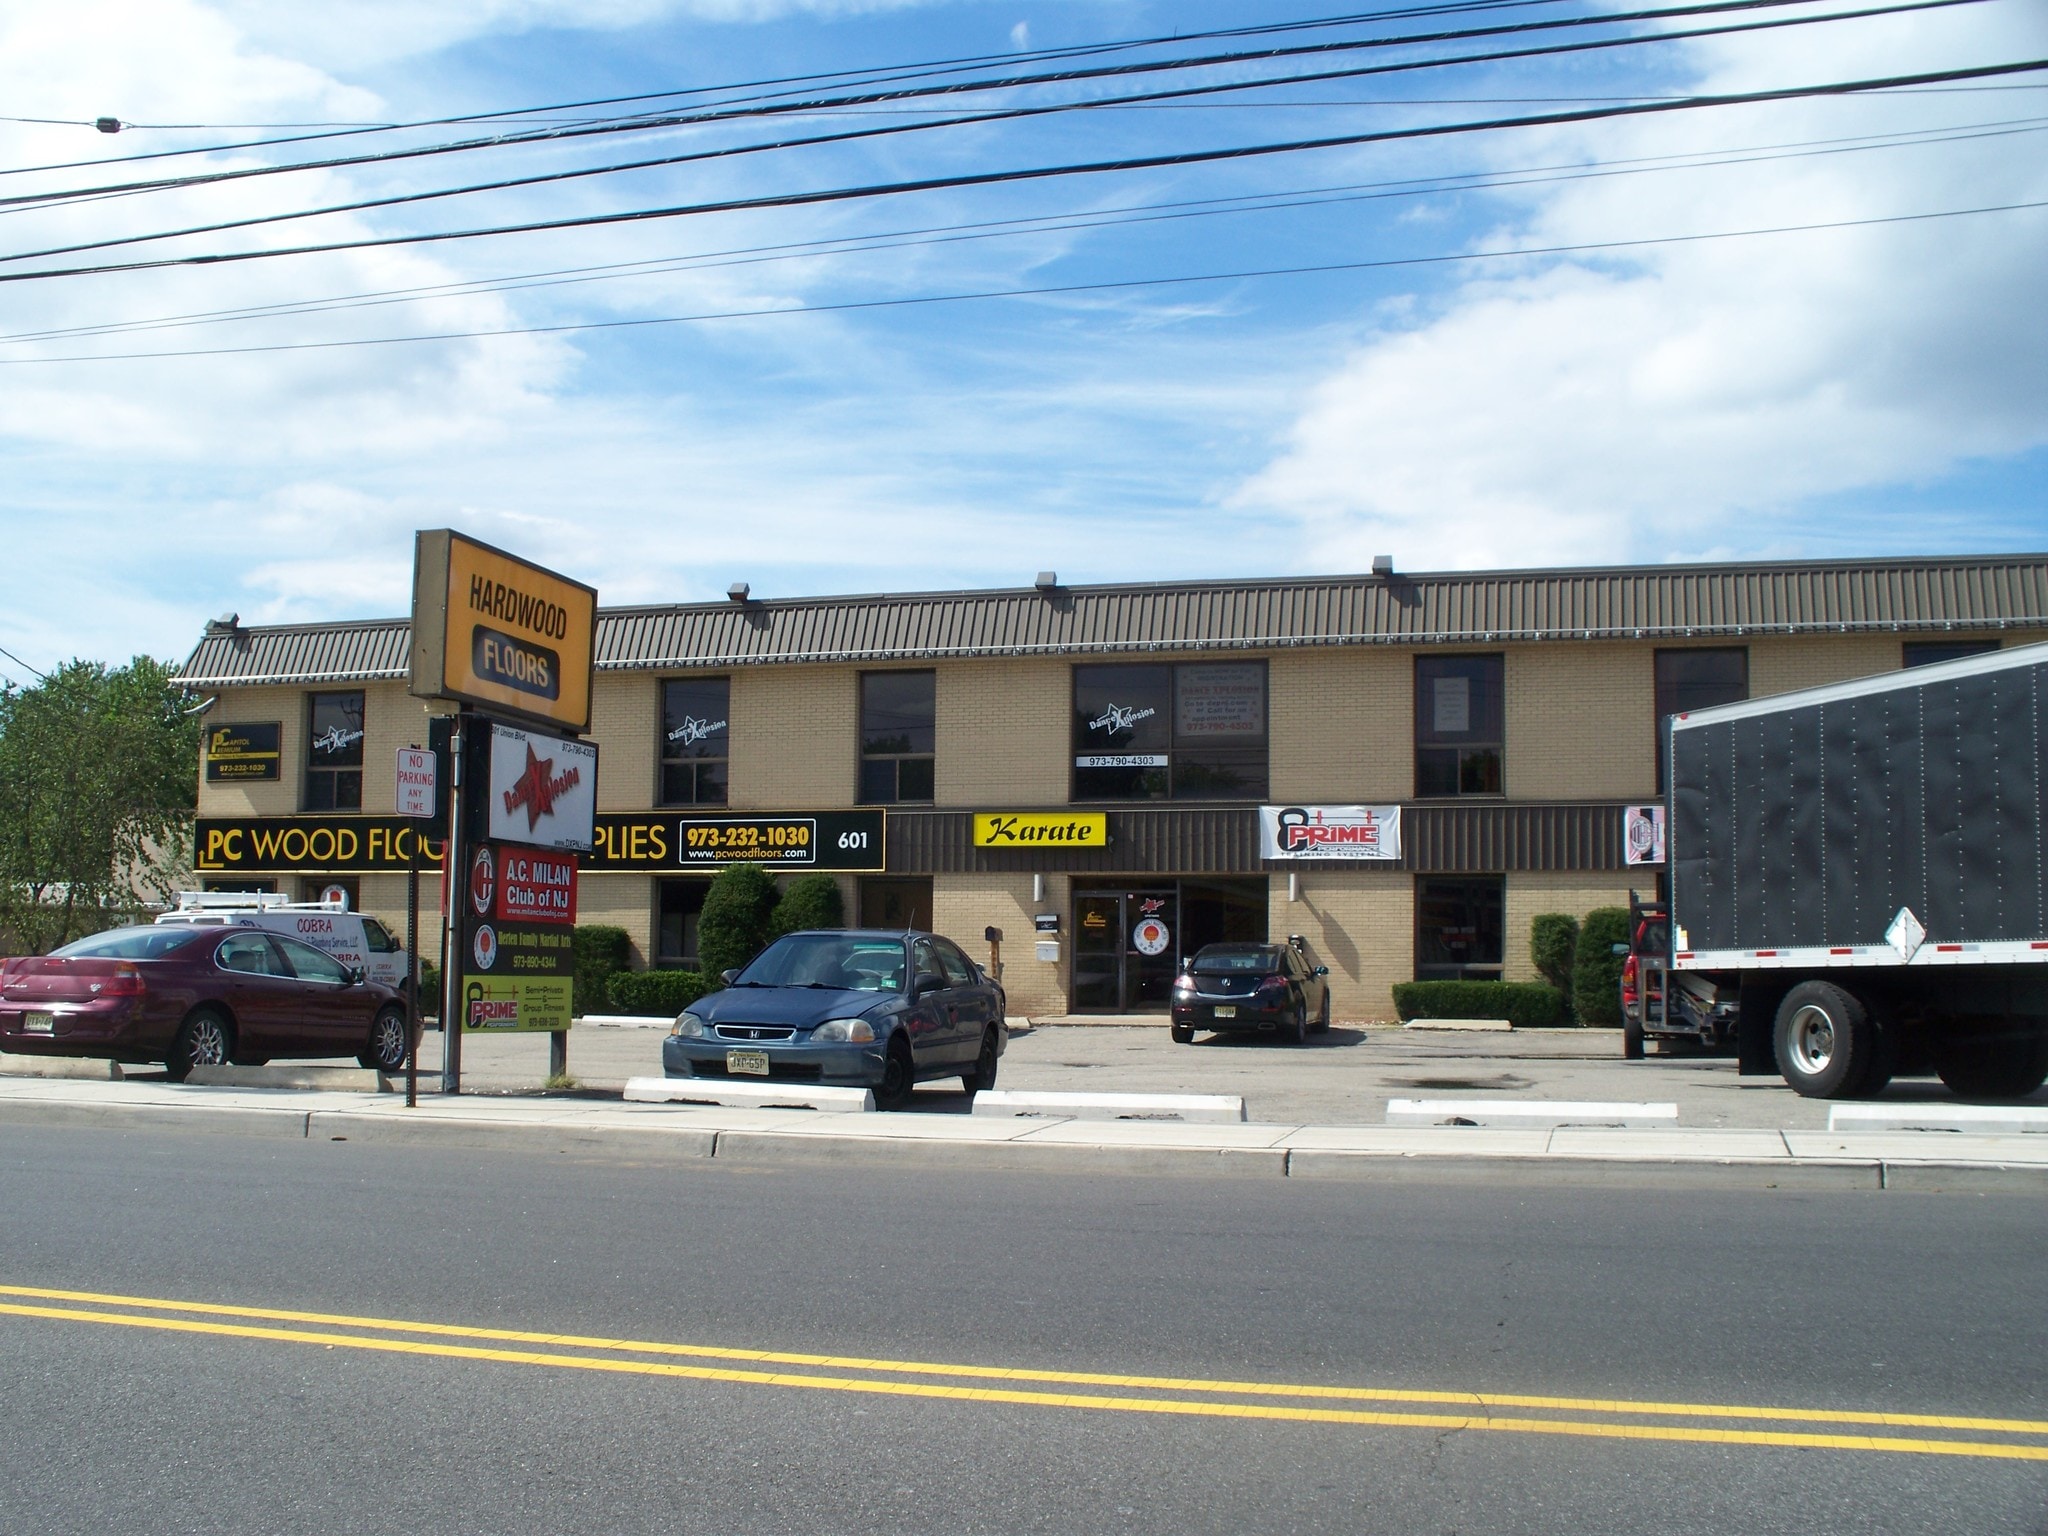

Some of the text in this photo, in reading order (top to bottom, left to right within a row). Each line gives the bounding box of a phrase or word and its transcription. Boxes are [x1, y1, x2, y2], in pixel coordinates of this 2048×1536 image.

[469, 573, 567, 641] HARDWOOD
[483, 638, 549, 688] FLOORS
[500, 728, 515, 739] Union
[219, 764, 266, 772] 973-232-1030
[409, 754, 424, 768] NO
[1089, 756, 1155, 766] 973-790-4303
[399, 770, 434, 786] PARKING
[408, 789, 423, 798] ANY
[407, 801, 424, 812] TIME
[687, 826, 810, 847] 973-232-1030
[985, 816, 1093, 844] Karate
[1287, 824, 1380, 850] PRIME
[207, 828, 243, 861] PC
[251, 828, 358, 861] WOOD
[837, 831, 868, 850] 601
[688, 847, 807, 859] www.pcwoodfloors.com
[506, 859, 571, 886] A.C. MILAN
[506, 885, 569, 909] Club of NJ
[297, 918, 333, 933] COBRA
[470, 1000, 518, 1027] PRIME
[523, 1004, 542, 1013] Group
